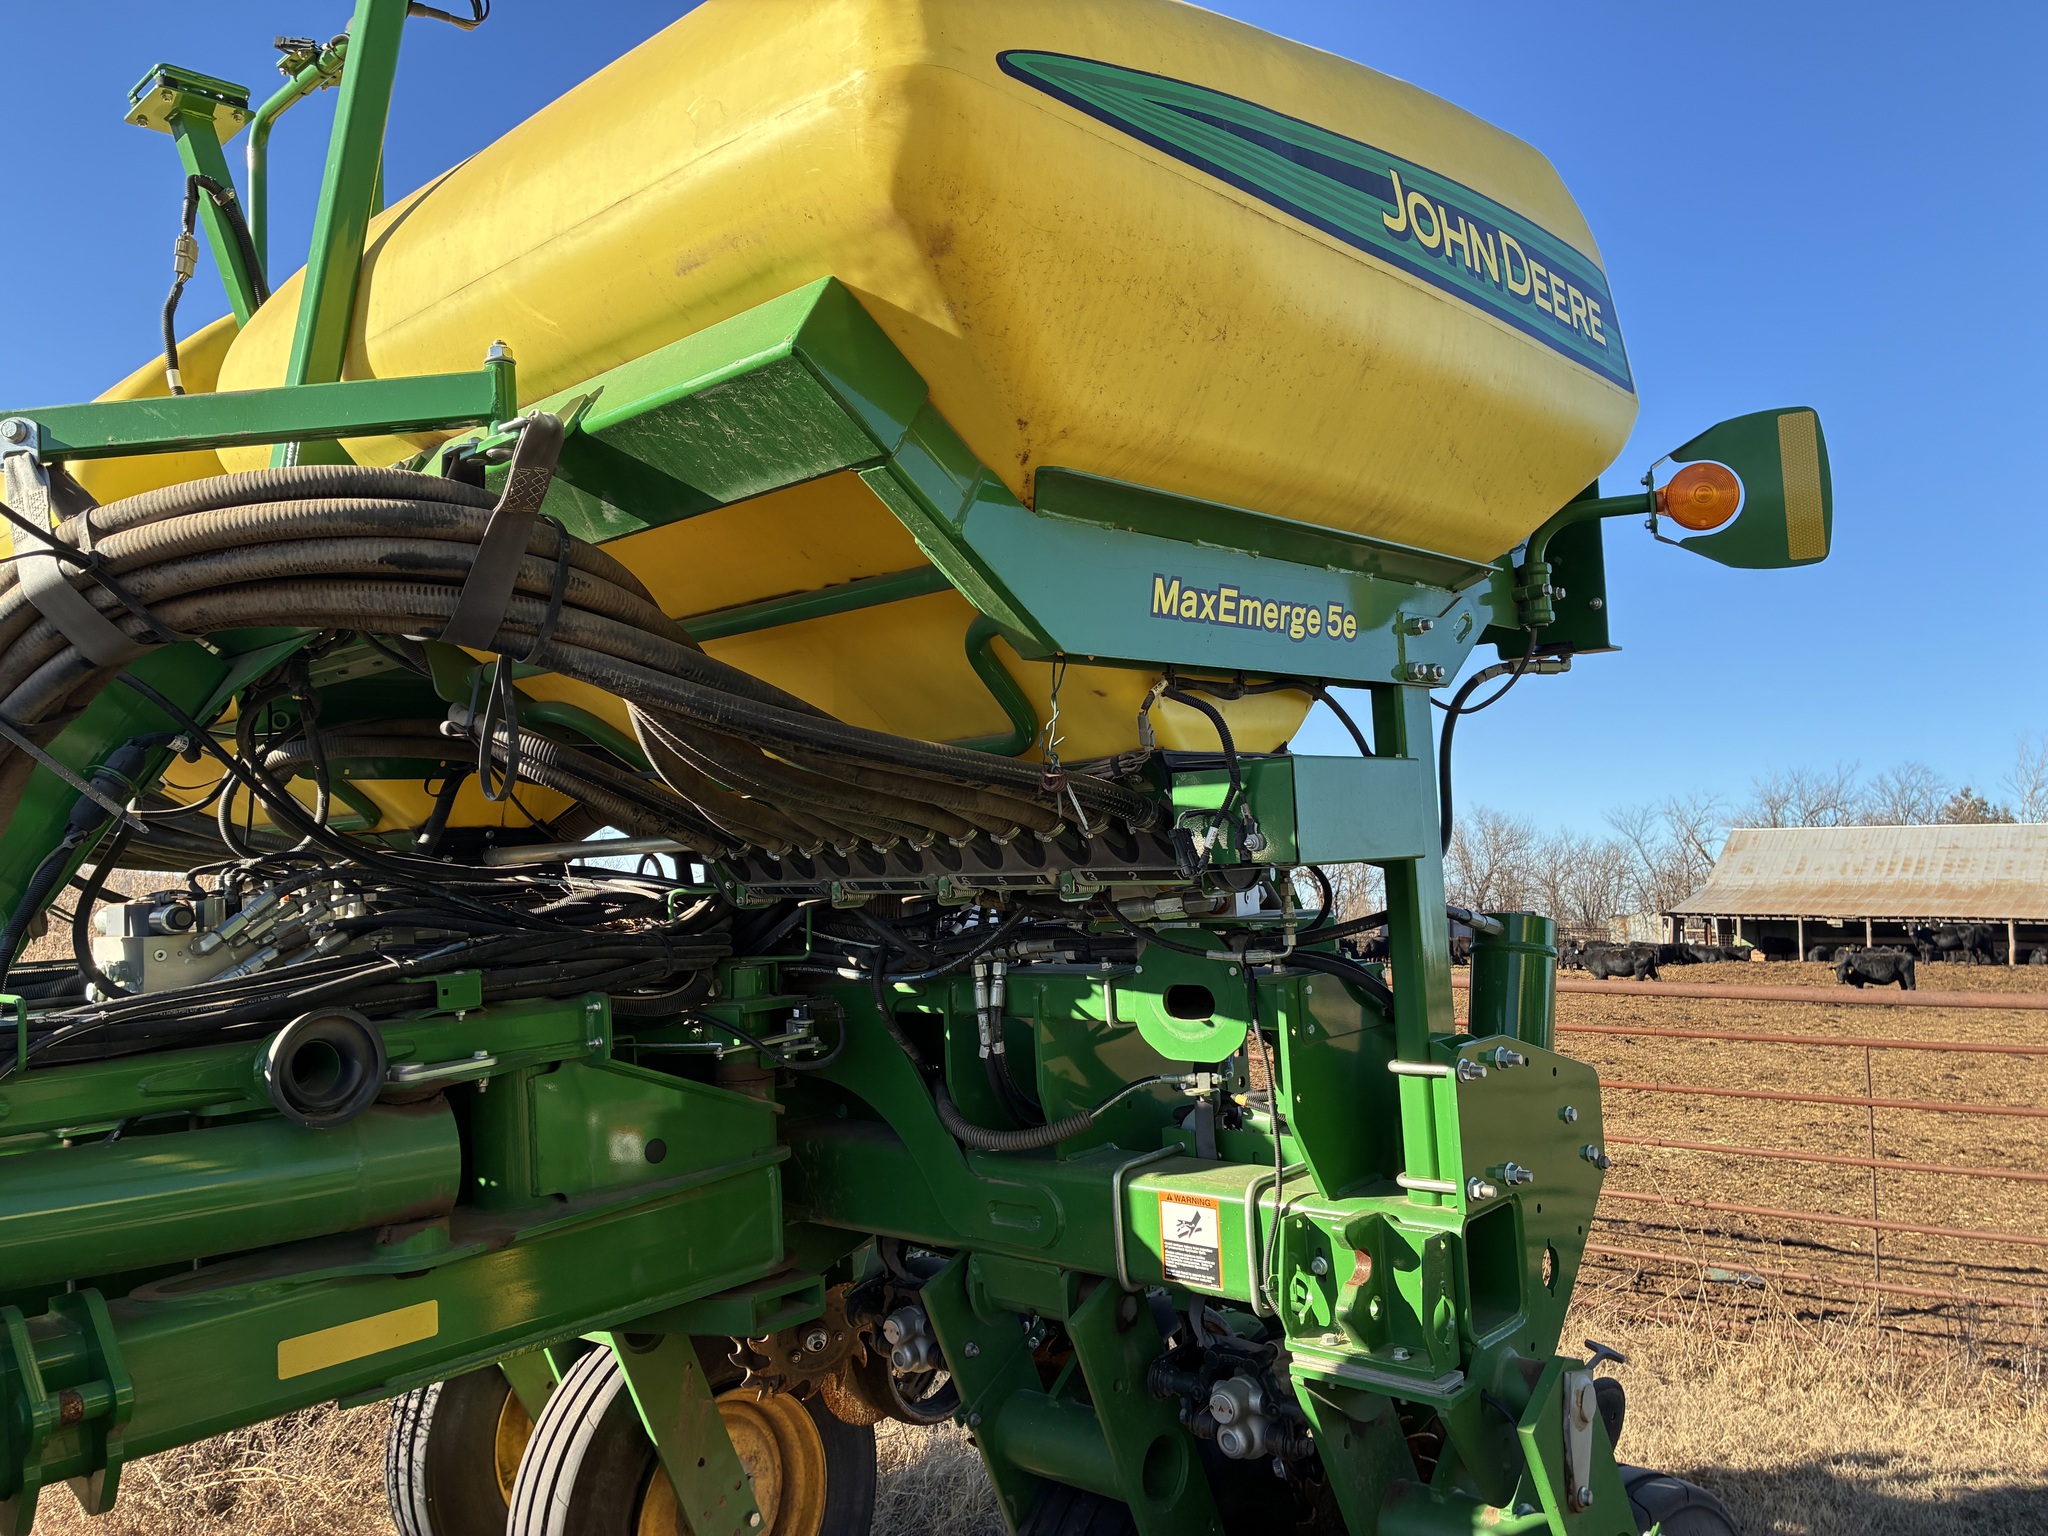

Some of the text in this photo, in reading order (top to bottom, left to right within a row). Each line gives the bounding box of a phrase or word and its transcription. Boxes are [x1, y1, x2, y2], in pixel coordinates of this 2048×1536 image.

[1382, 168, 1607, 347] JOHN DEERE
[1152, 577, 1357, 640] MaxEmerge 5e
[961, 875, 1045, 886] 6 5 4
[1086, 871, 1098, 882] 3
[1128, 871, 1140, 881] 2
[851, 881, 923, 891] 9 8 7
[1174, 1194, 1211, 1207] WARNING
